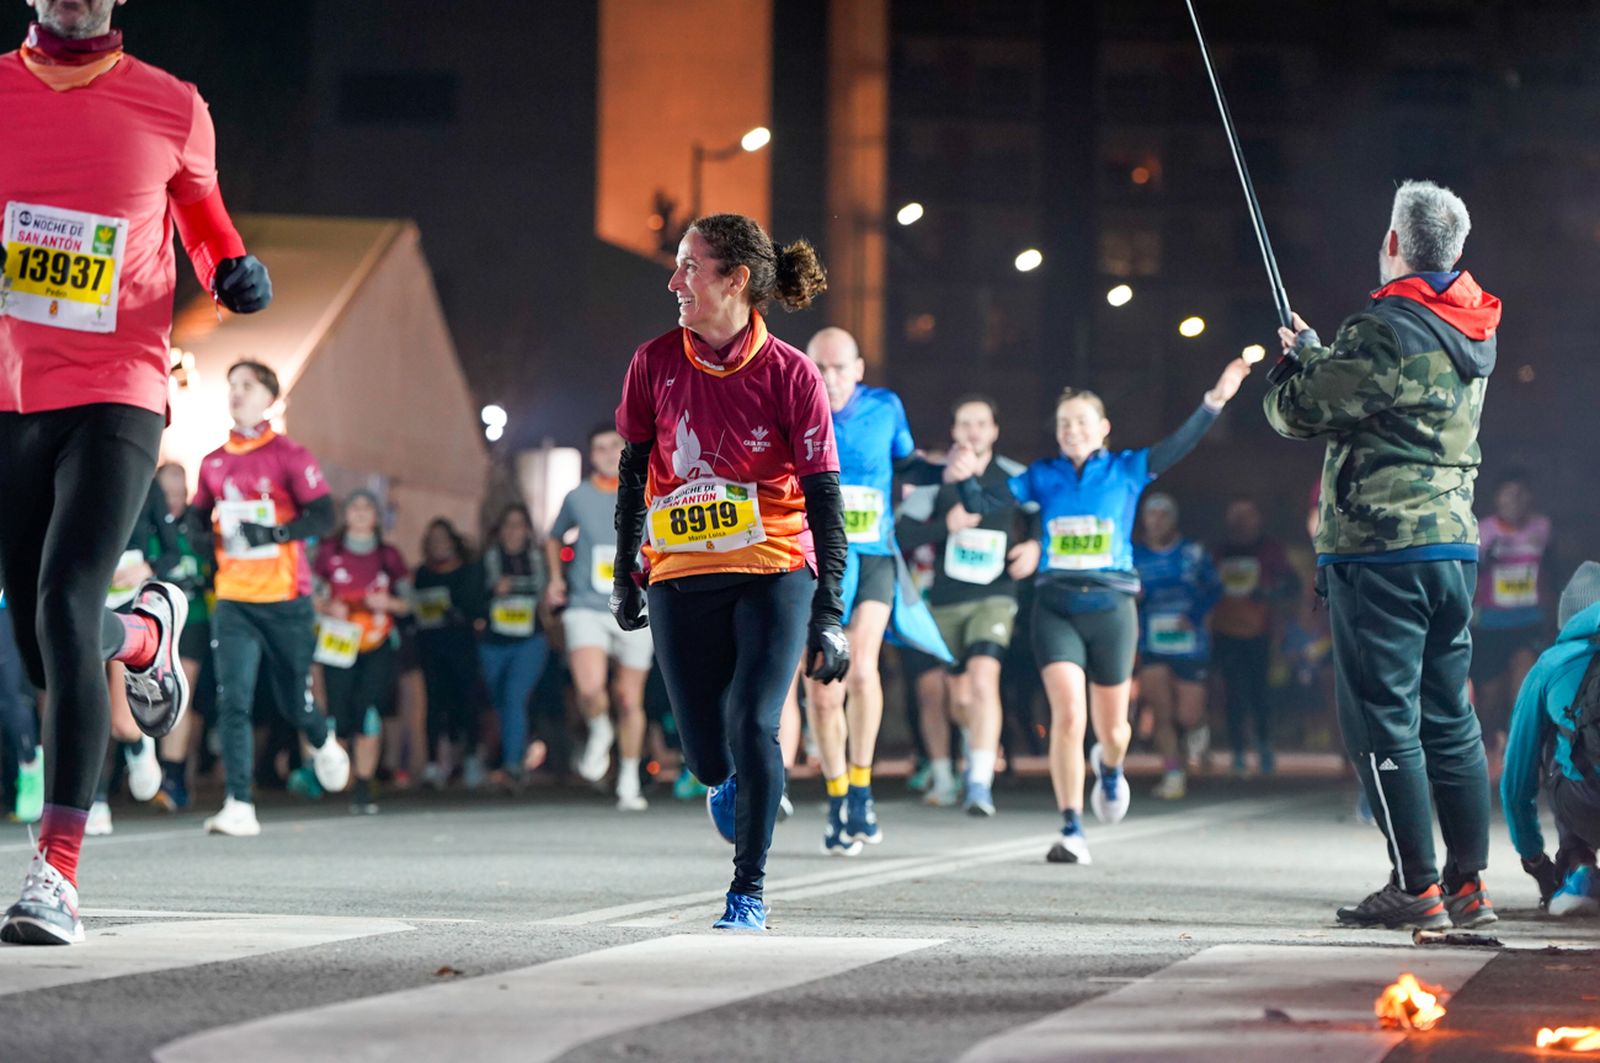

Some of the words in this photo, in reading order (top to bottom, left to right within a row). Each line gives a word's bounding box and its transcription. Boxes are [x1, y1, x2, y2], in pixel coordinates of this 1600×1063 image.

[32, 218, 67, 234] NOCHE
[70, 223, 85, 237] DE
[17, 229, 39, 244] SAN
[40, 234, 83, 252] ANTÓN
[18, 246, 107, 292] 13937
[704, 483, 717, 492] DE
[681, 492, 717, 505] ANTÓN
[669, 501, 738, 536] 8919
